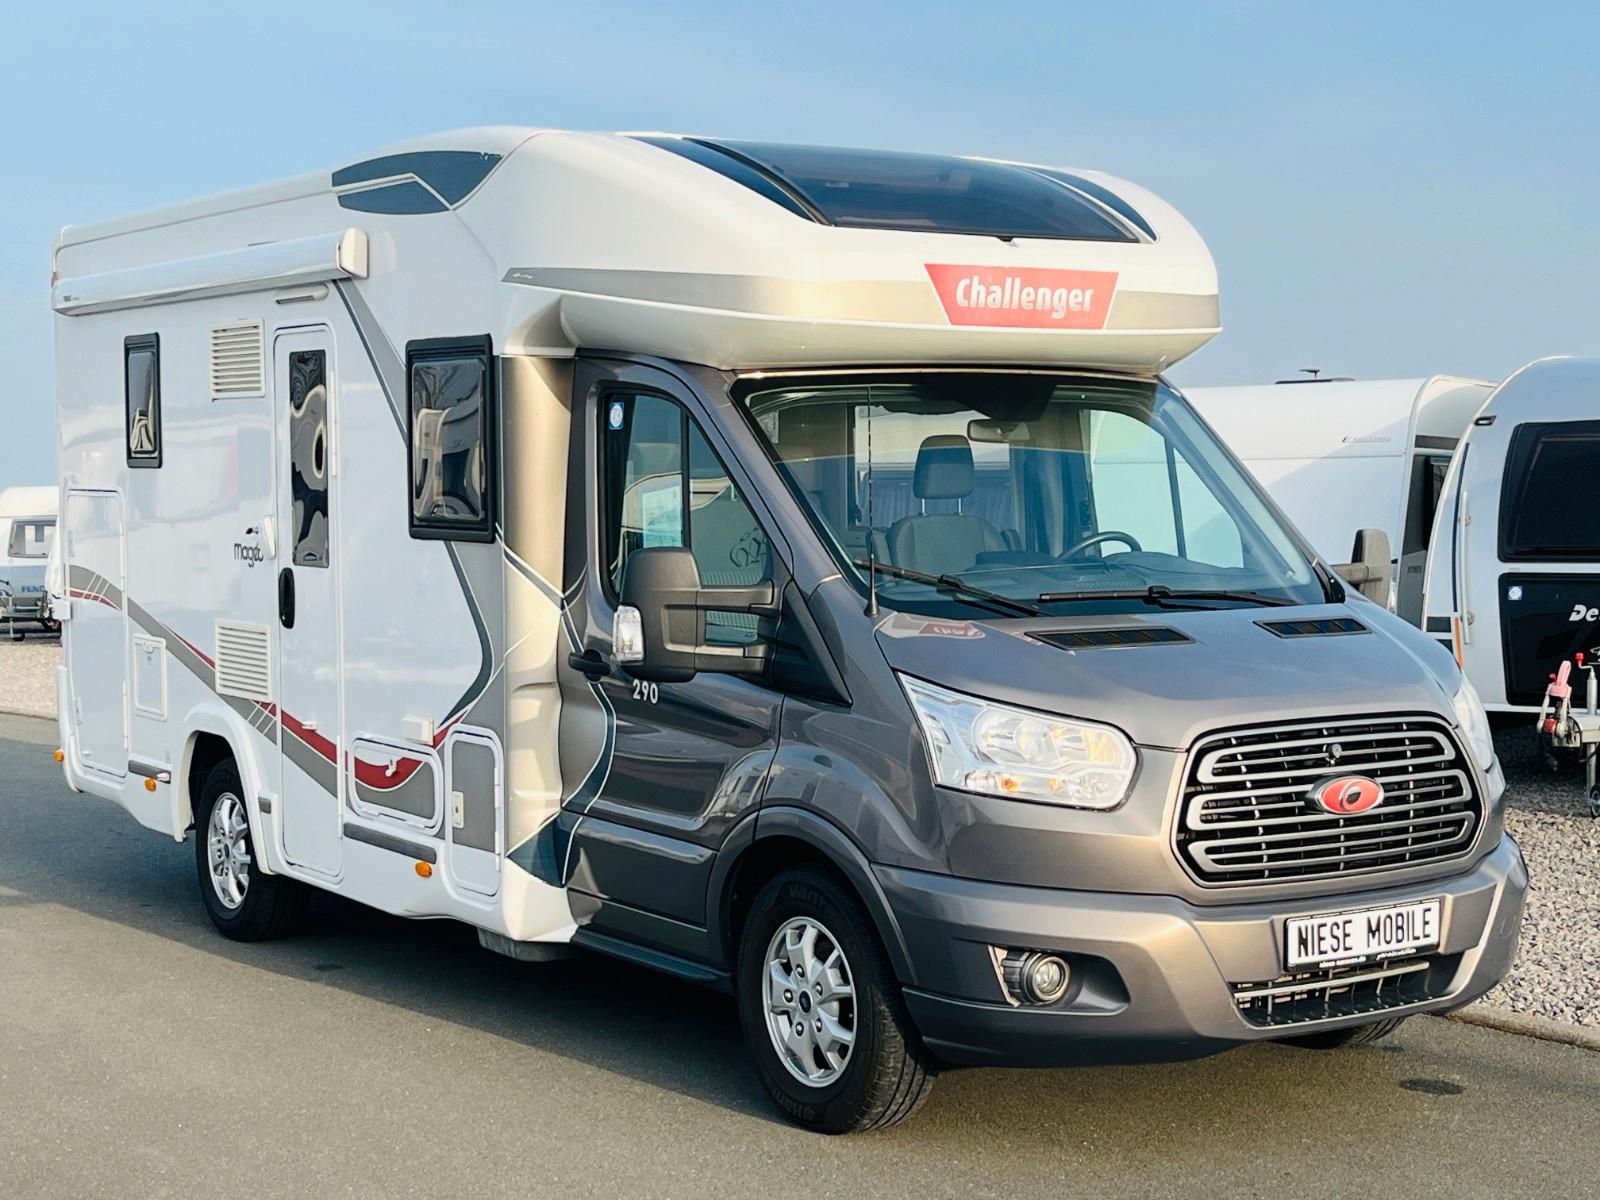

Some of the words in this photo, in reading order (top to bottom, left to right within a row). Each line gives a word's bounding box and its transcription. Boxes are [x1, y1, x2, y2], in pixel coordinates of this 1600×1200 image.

[956, 275, 1094, 320] Challenger
[1568, 604, 1600, 622] De
[632, 678, 658, 704] 290
[1298, 920, 1353, 958] NIESE
[1367, 908, 1431, 948] MOBILE
